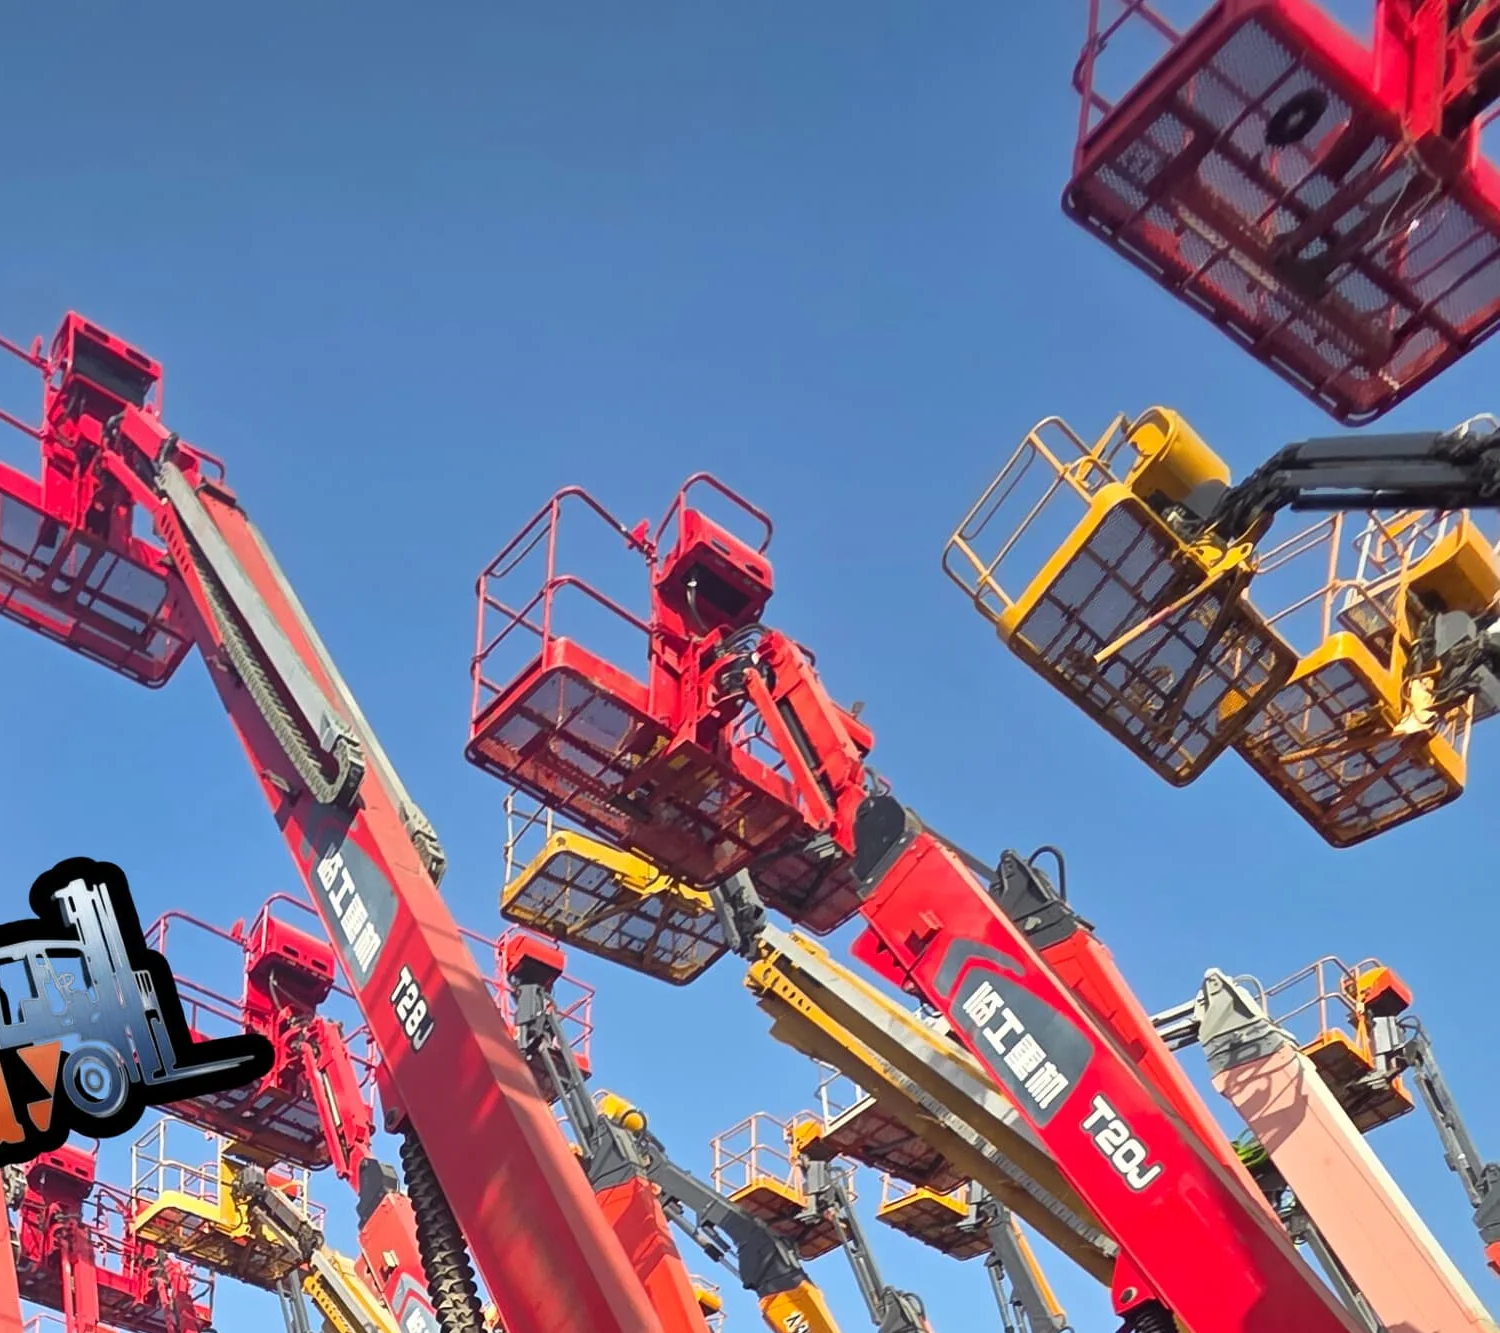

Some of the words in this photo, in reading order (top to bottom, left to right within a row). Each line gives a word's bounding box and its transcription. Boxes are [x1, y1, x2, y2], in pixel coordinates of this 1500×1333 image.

[391, 965, 435, 1051] T28J
[962, 981, 1069, 1110] 临工重机
[1082, 1094, 1162, 1190] T20J
